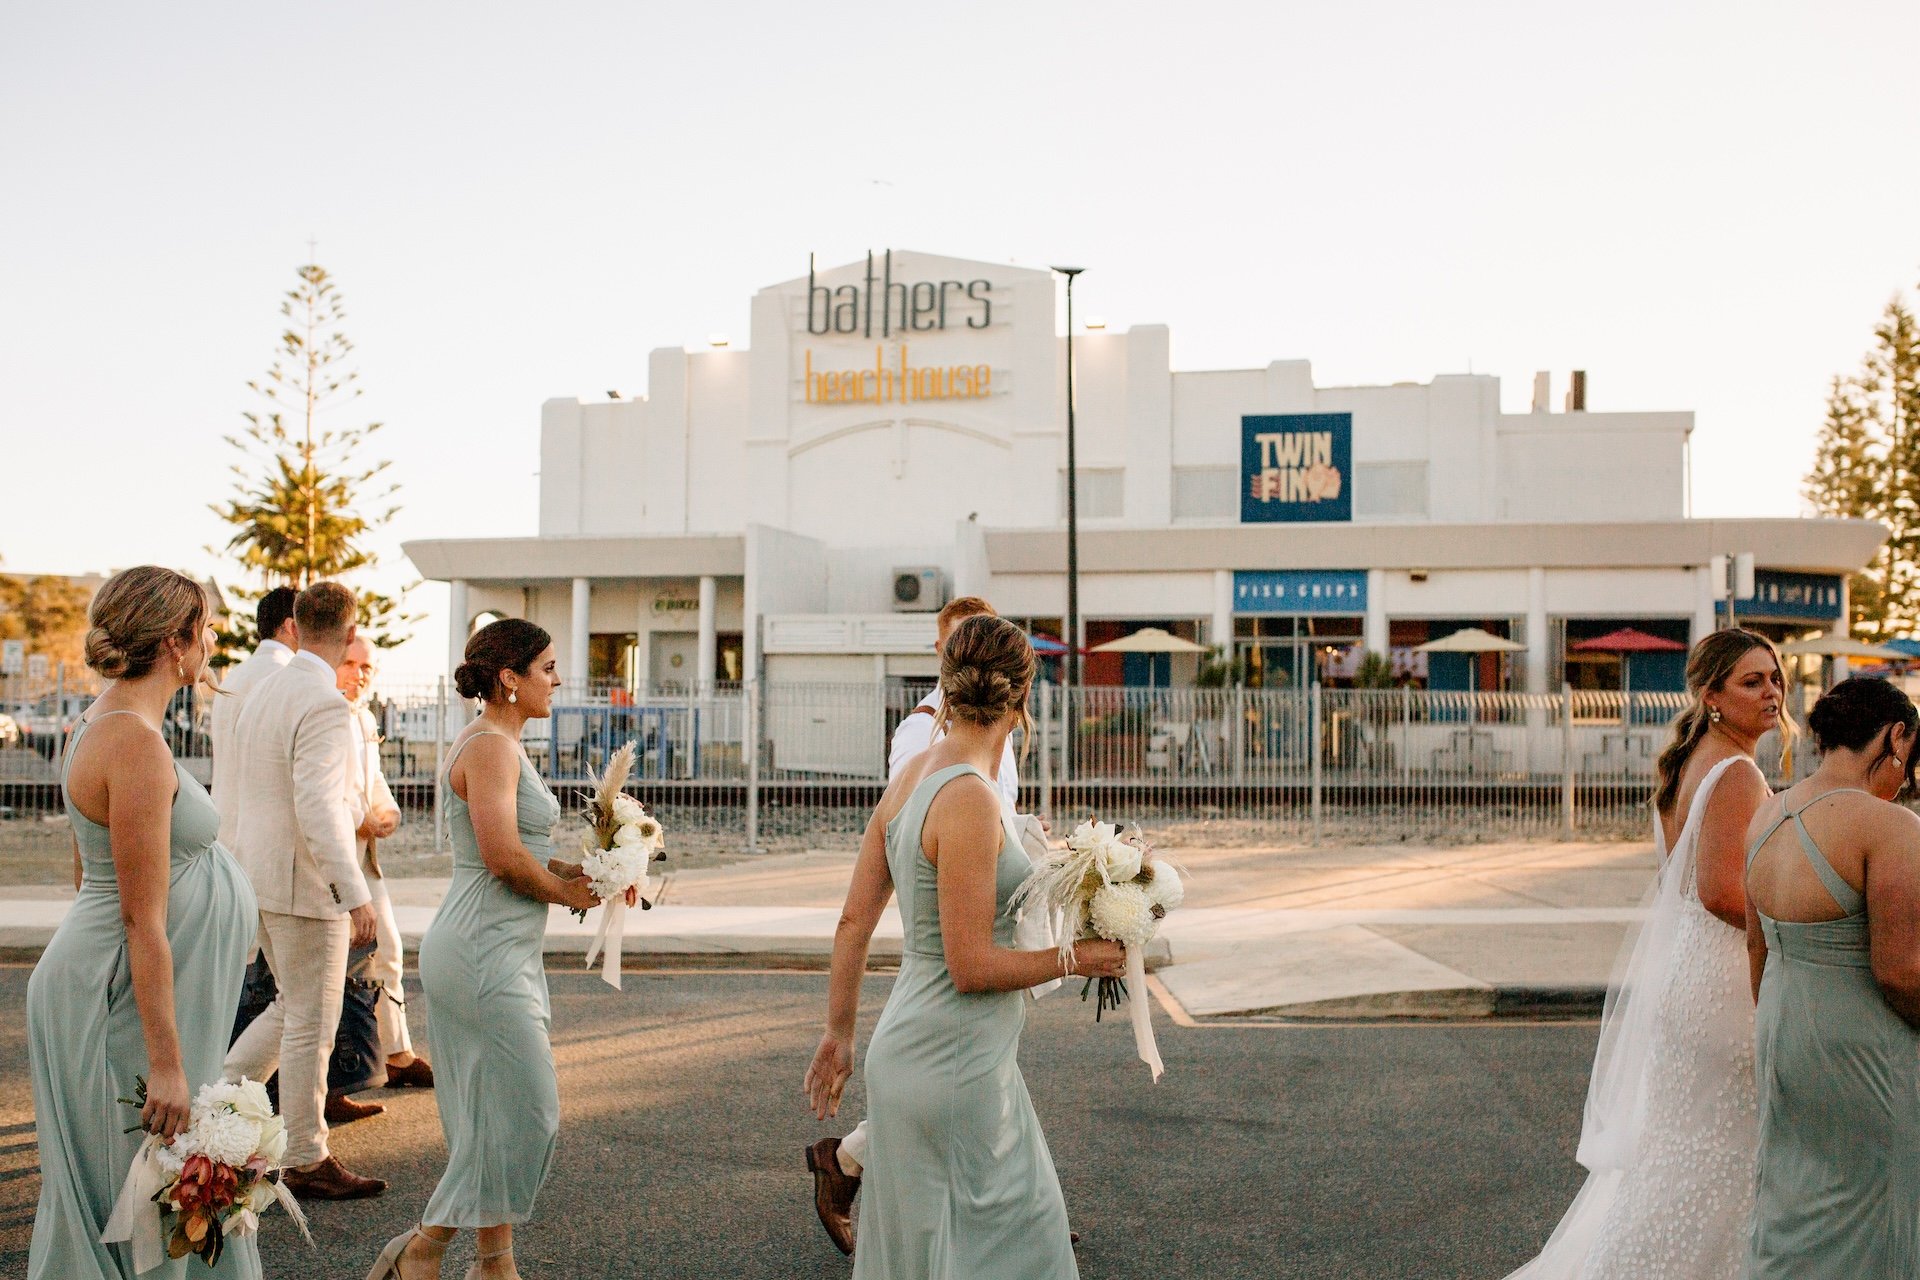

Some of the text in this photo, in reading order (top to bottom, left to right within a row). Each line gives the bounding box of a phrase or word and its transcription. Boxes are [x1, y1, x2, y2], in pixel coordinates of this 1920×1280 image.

[807, 248, 991, 339] bathers
[805, 344, 992, 406] beach house
[1255, 431, 1332, 468] TWIN
[1261, 468, 1322, 503] FIN
